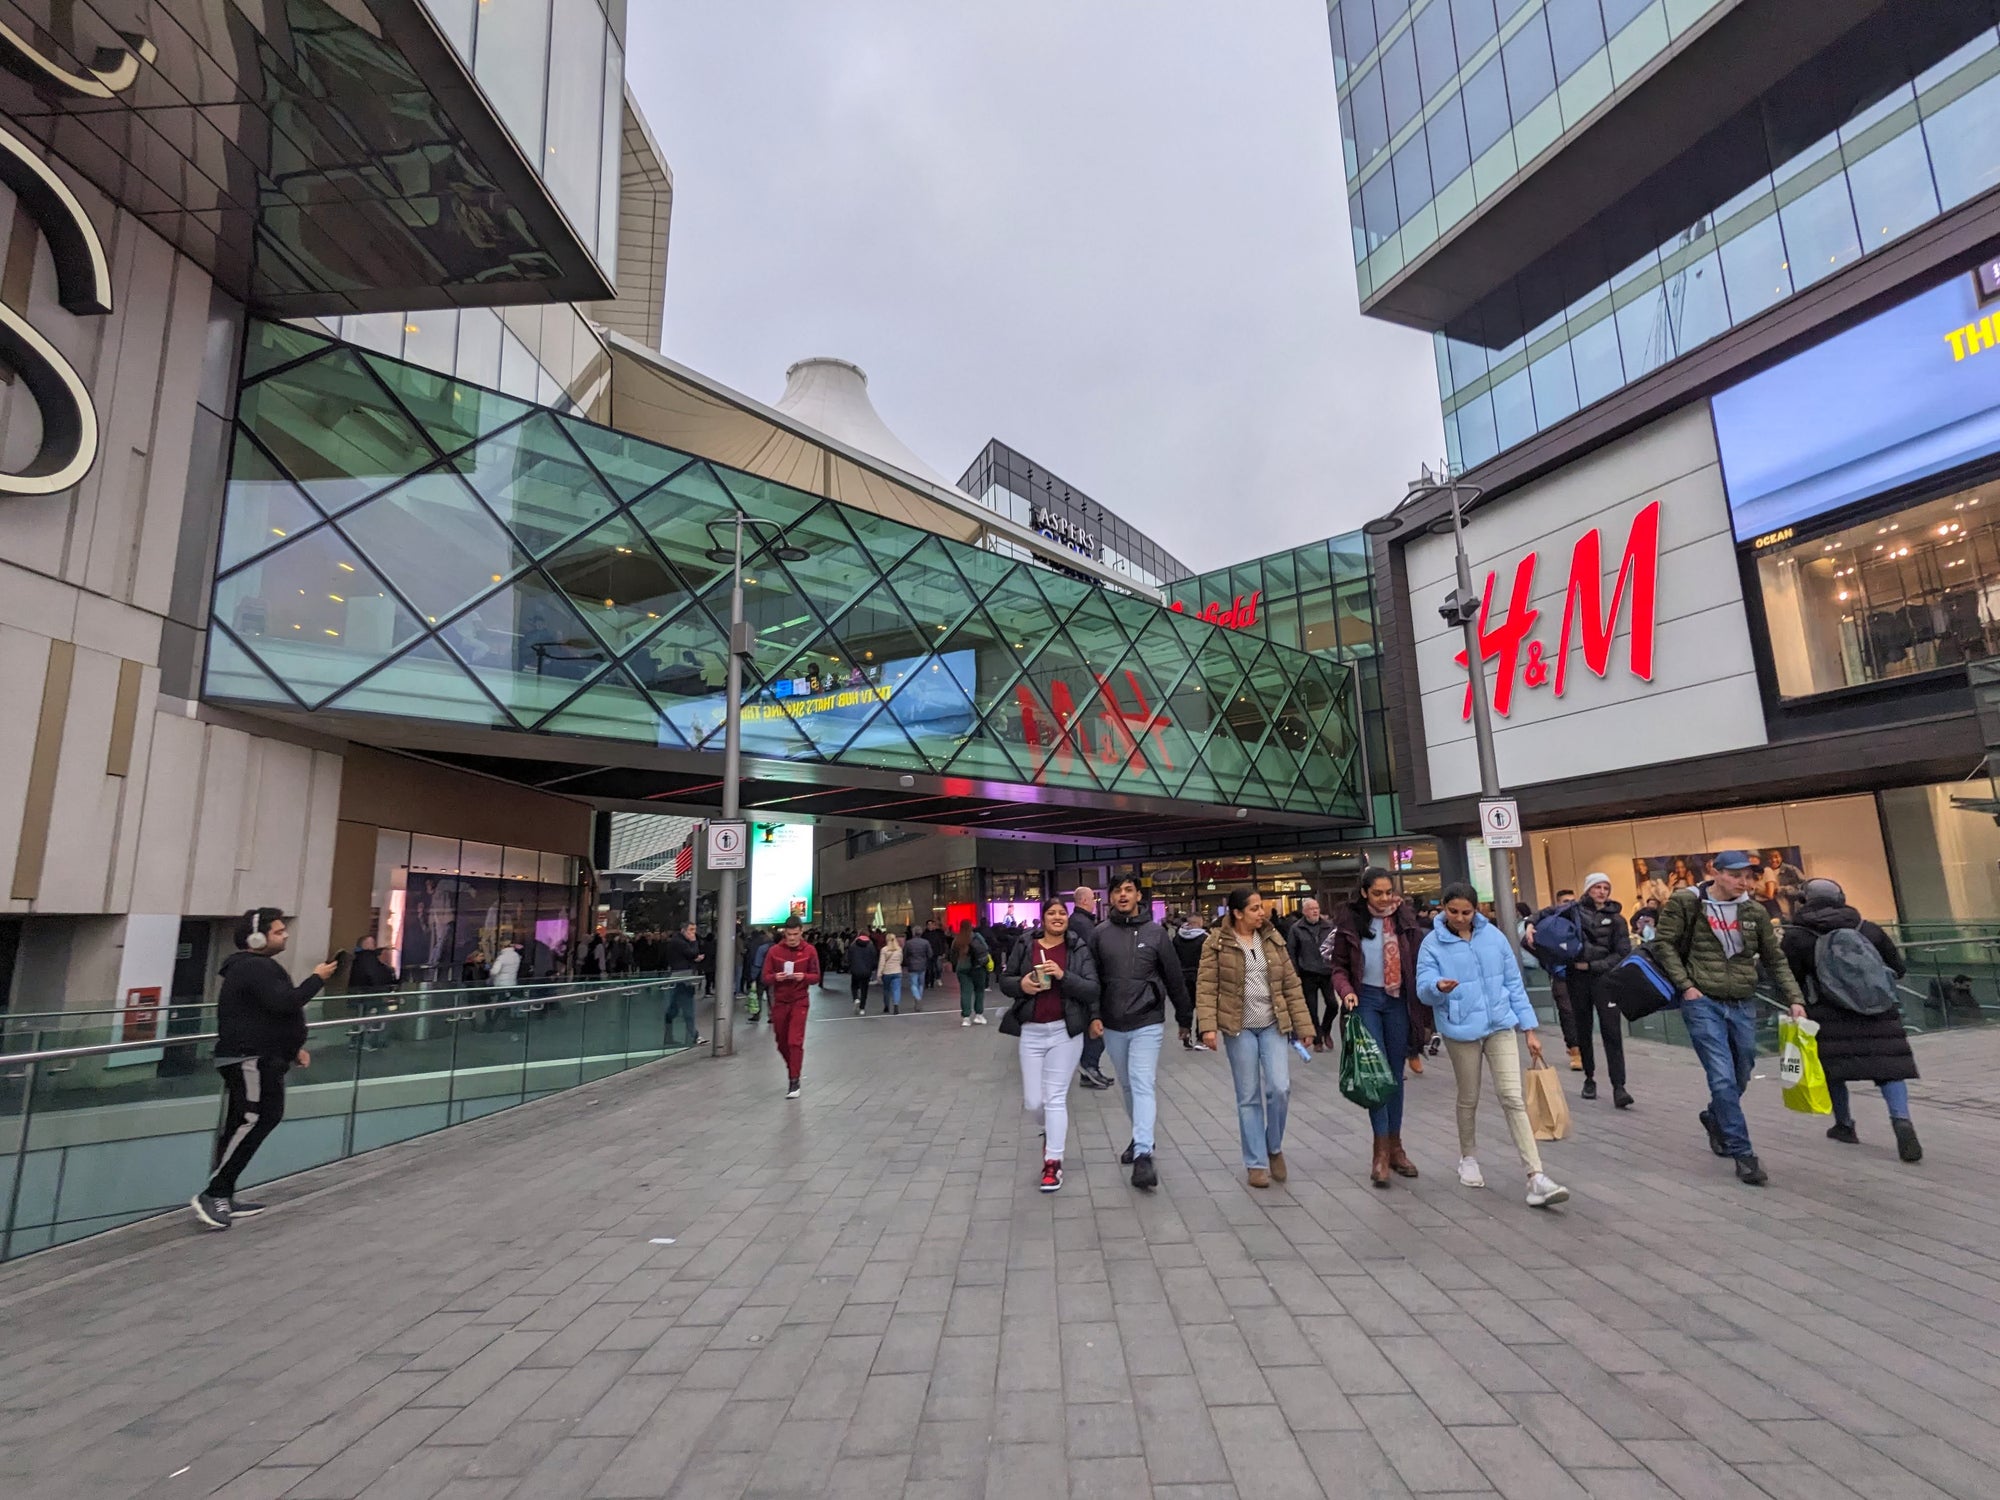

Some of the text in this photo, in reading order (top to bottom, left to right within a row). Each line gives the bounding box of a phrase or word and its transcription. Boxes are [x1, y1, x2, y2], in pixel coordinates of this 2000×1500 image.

[1040, 507, 1095, 550] ASPERS
[1755, 527, 1794, 549] OCEAN
[1453, 500, 1661, 723] H&M
